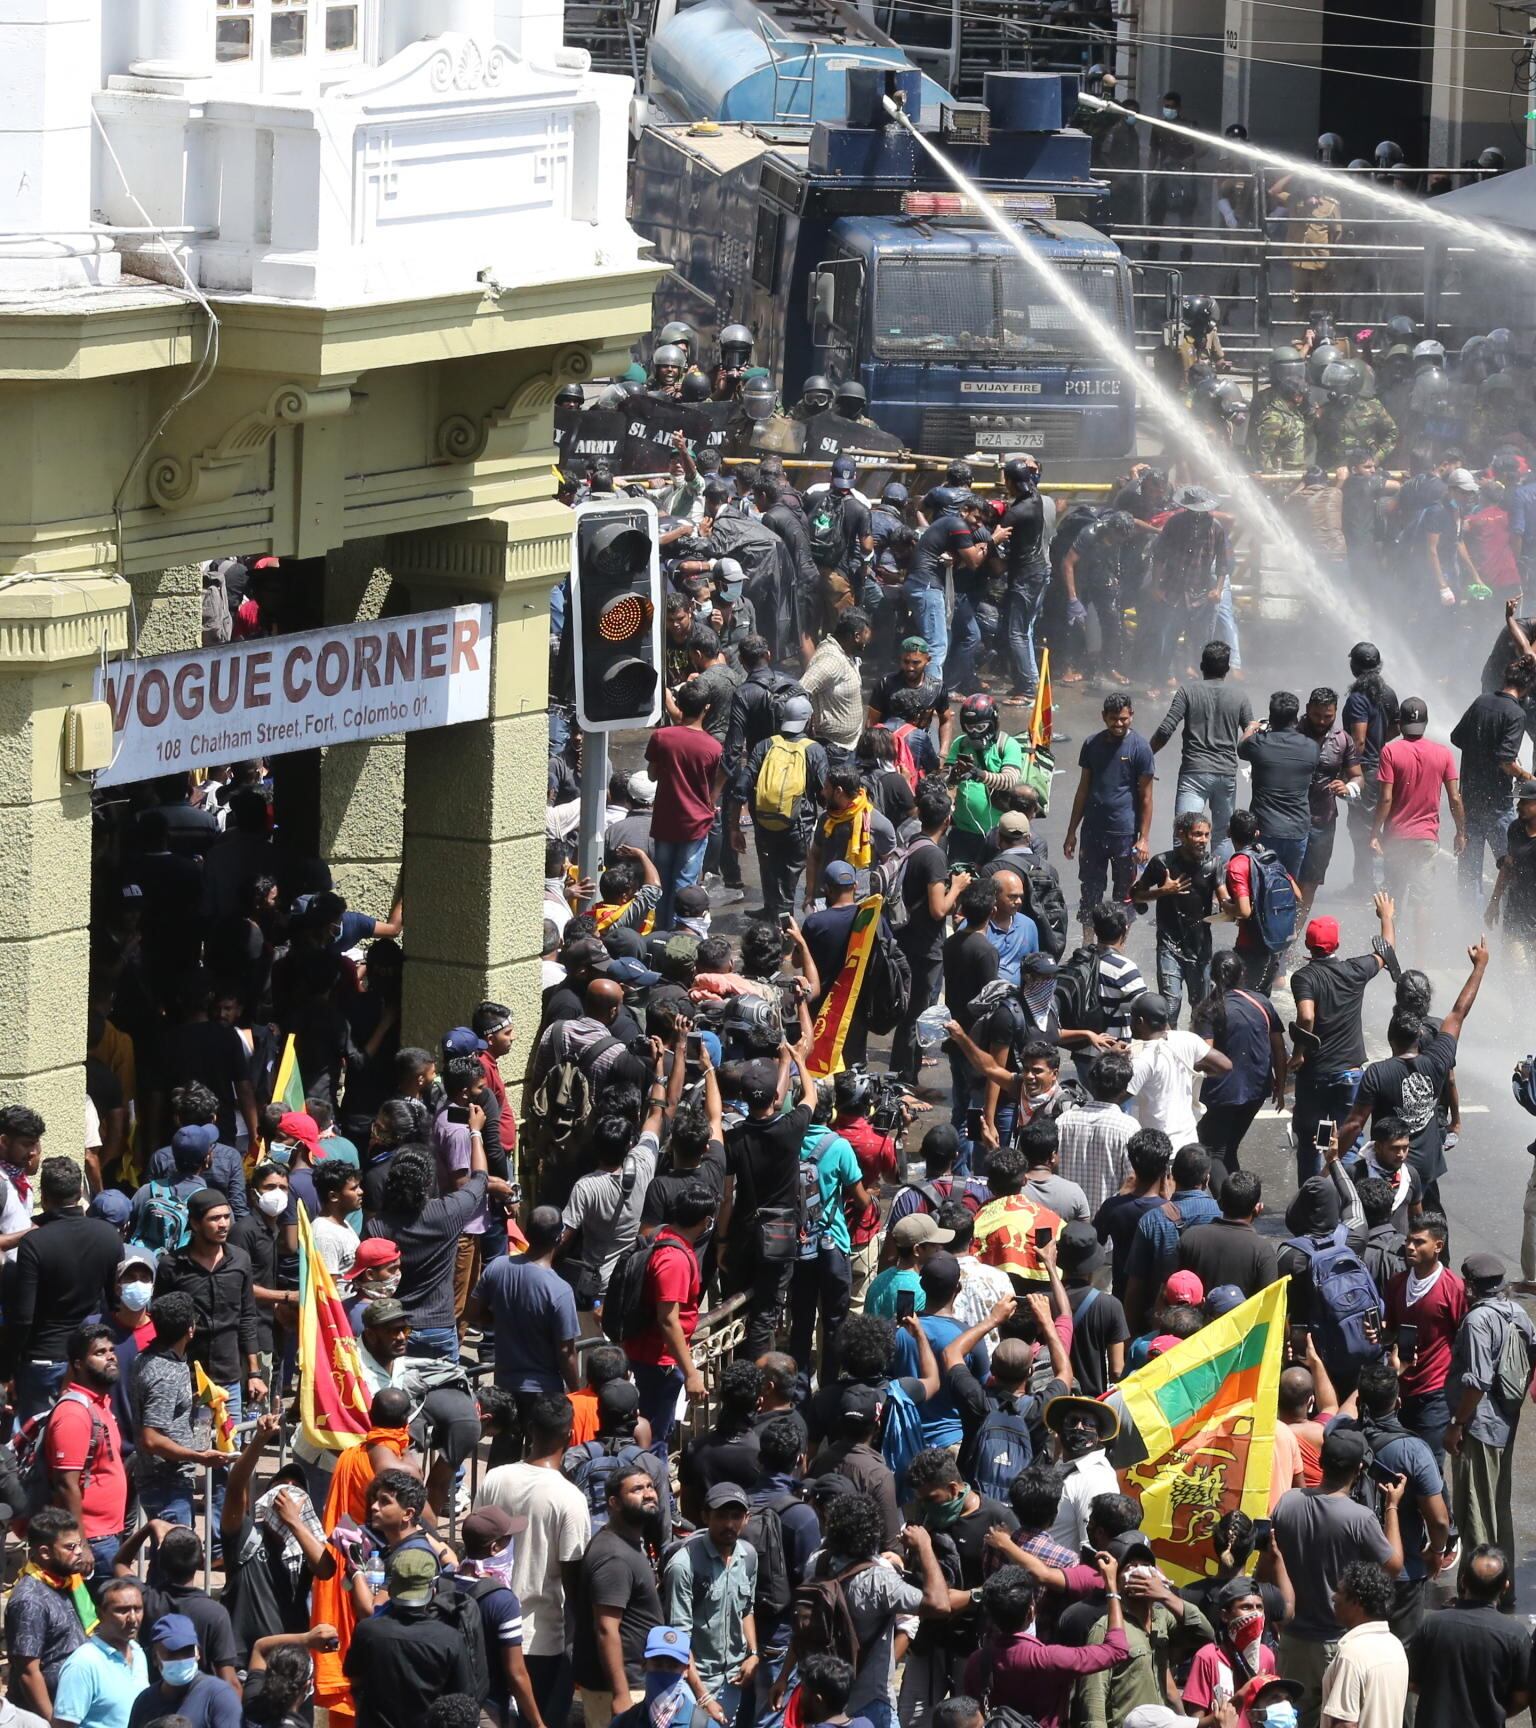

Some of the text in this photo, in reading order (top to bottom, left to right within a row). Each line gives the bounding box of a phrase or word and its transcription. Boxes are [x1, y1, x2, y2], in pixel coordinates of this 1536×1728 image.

[976, 384, 1039, 392] VIJAY FIRE
[1065, 380, 1121, 395] POLICE
[969, 415, 1032, 428] MAN
[628, 421, 697, 450] SL ARY
[575, 440, 618, 454] ARMY
[820, 437, 838, 454] SL
[102, 618, 480, 732] VOGUE CORNER
[156, 741, 181, 762] 108
[190, 728, 252, 755] Chatham
[257, 721, 302, 744] Street,
[304, 713, 337, 735] Fort,
[343, 702, 409, 727] Colombo
